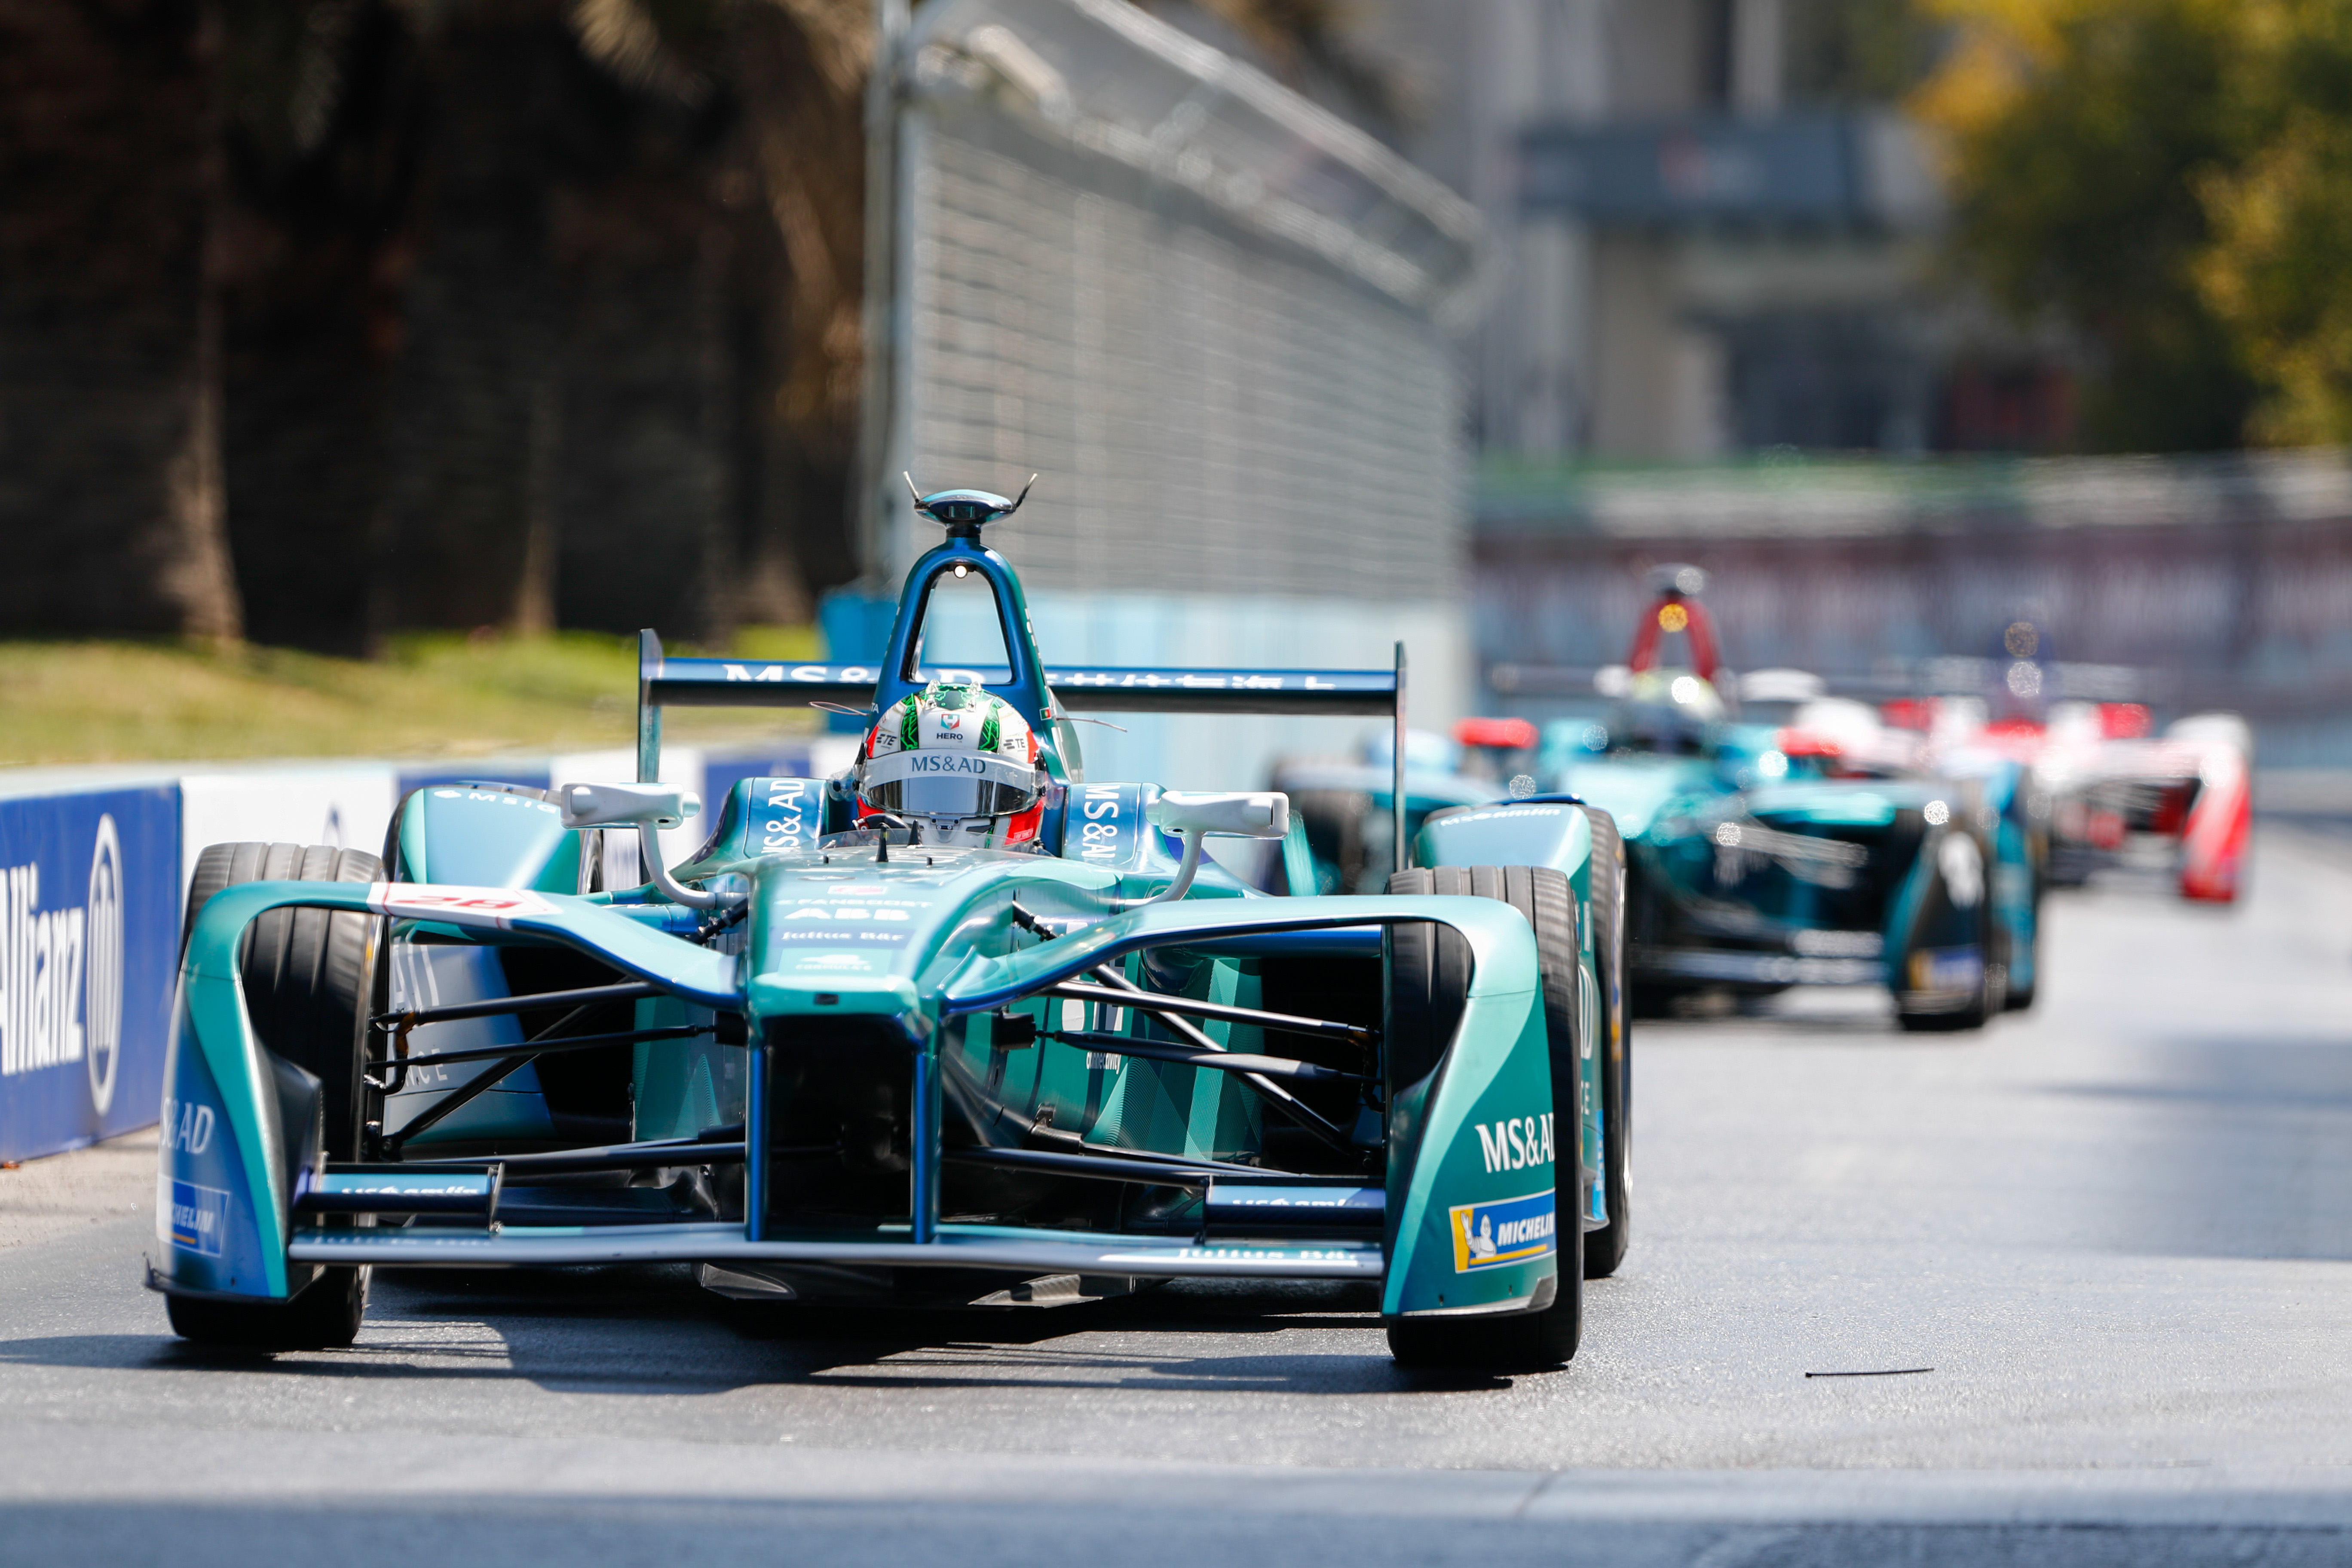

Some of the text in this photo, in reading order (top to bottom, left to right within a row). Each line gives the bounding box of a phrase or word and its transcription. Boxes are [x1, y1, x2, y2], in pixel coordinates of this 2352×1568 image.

[722, 664, 986, 683] MS&D
[911, 756, 986, 773] MS&AD
[468, 792, 557, 814] MSIG
[390, 895, 524, 910] 28
[784, 908, 910, 920] ABB
[162, 1097, 215, 1154] S&AD
[170, 1204, 214, 1233] HELIN
[1498, 1210, 1555, 1246] MICHELIN
